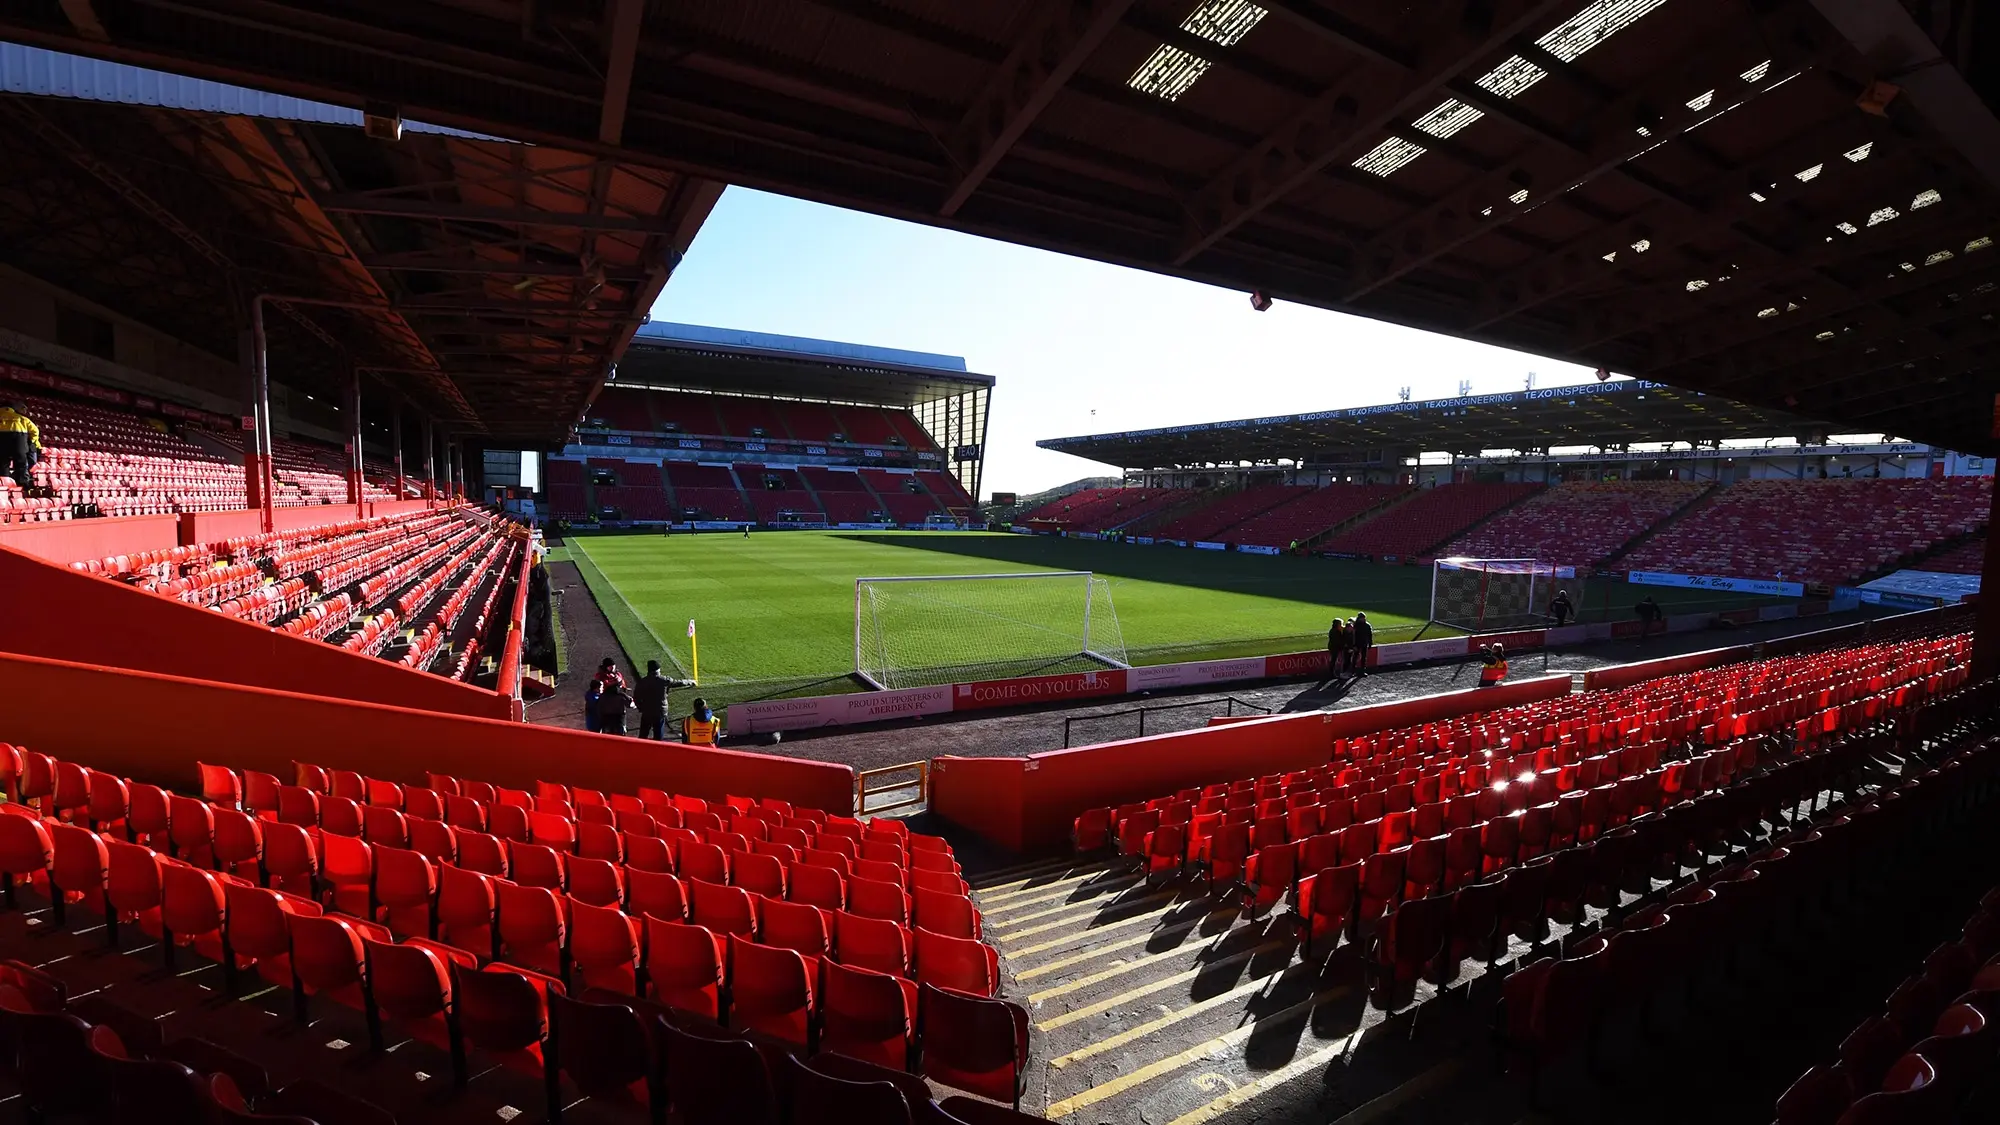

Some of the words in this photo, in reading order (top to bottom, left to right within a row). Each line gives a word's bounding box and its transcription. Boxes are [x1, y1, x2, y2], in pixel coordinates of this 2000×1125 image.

[957, 445, 976, 457] TEXO
[1687, 577, 1706, 586] The
[1278, 657, 1306, 671] COME
[1308, 655, 1322, 668] ON
[974, 686, 1017, 701] COME
[1021, 682, 1042, 696] ON
[1045, 680, 1073, 694] YOU
[746, 704, 786, 714] SIMMONS
[787, 701, 819, 711] ENERGY
[848, 699, 880, 710] PROUD
[881, 692, 932, 706] SUPPORTERS
[933, 691, 944, 700] OF
[868, 703, 915, 715] ABERDEEN
[916, 701, 927, 710] FC
